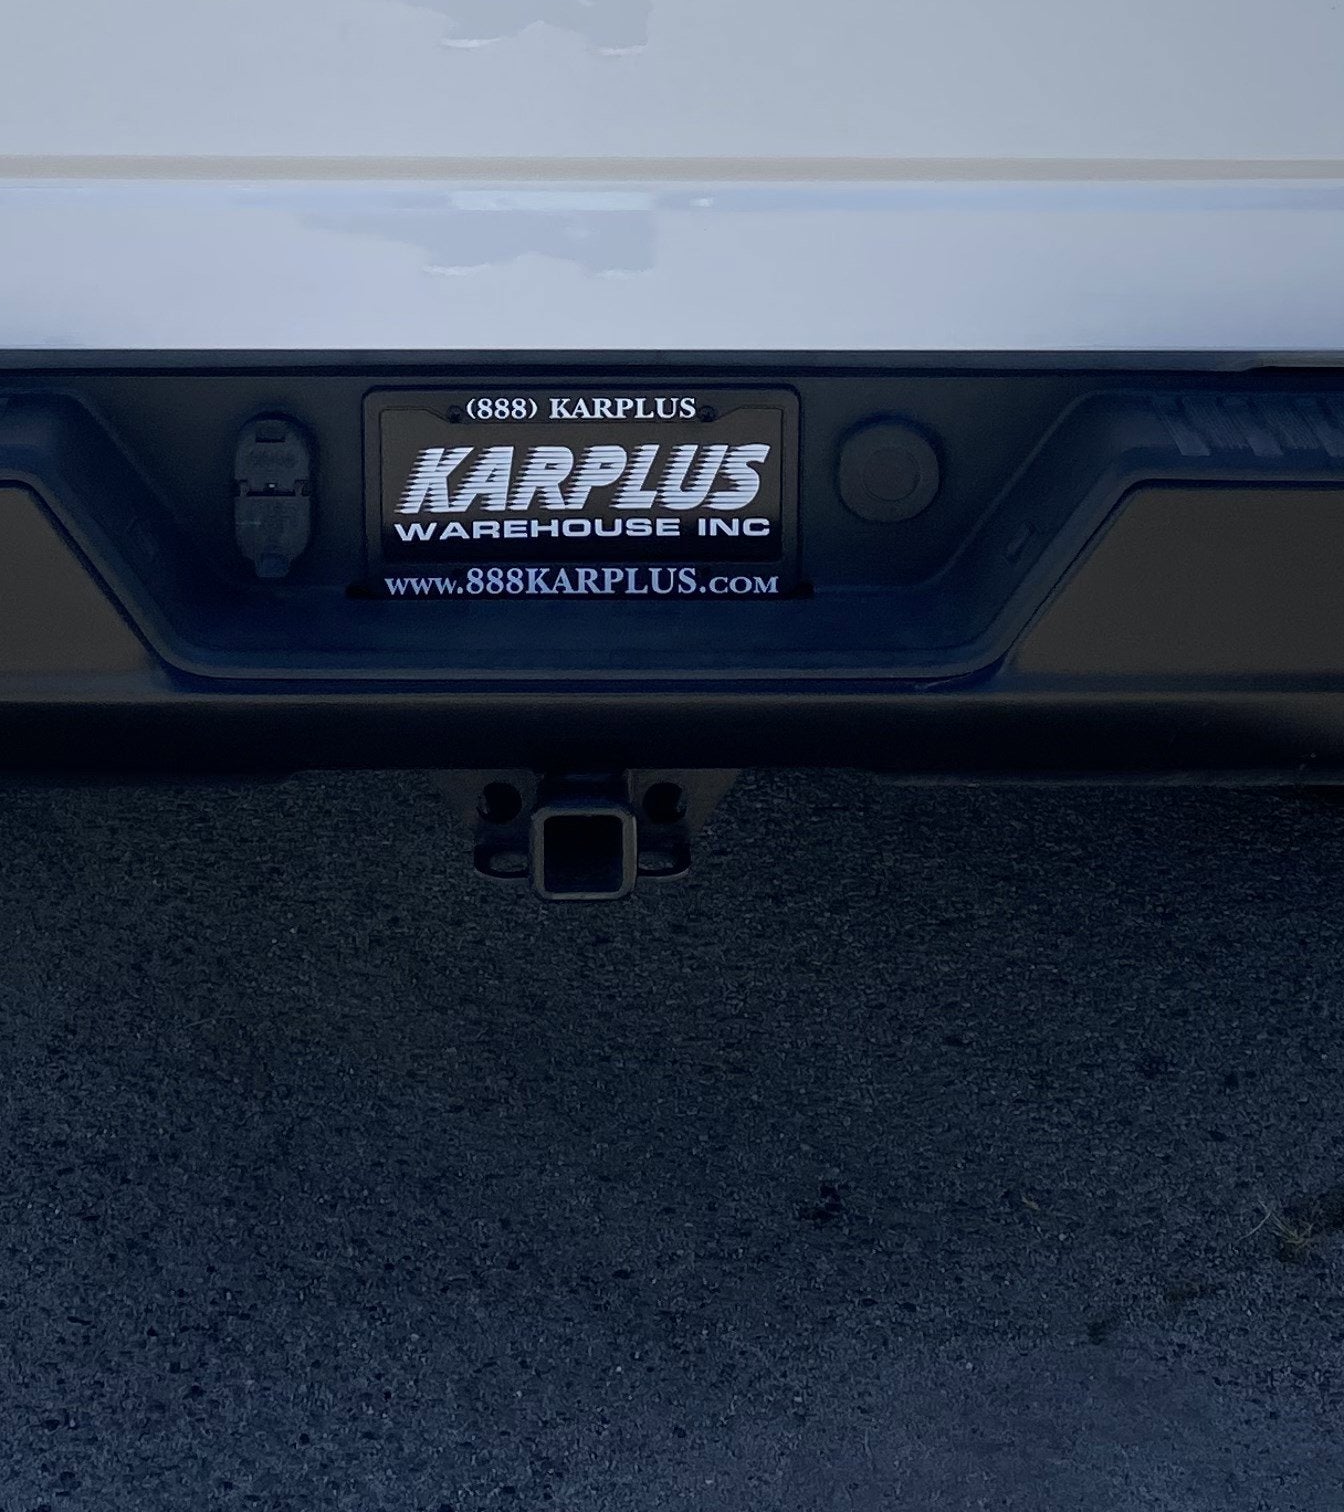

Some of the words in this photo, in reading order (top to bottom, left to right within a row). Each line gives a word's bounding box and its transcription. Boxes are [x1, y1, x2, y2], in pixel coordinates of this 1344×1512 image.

[465, 397, 538, 421] (888)
[548, 397, 697, 420] KARPLUS
[393, 443, 771, 515] KARPLUS
[393, 517, 681, 542] WAREHOUSE
[697, 517, 771, 538] INC
